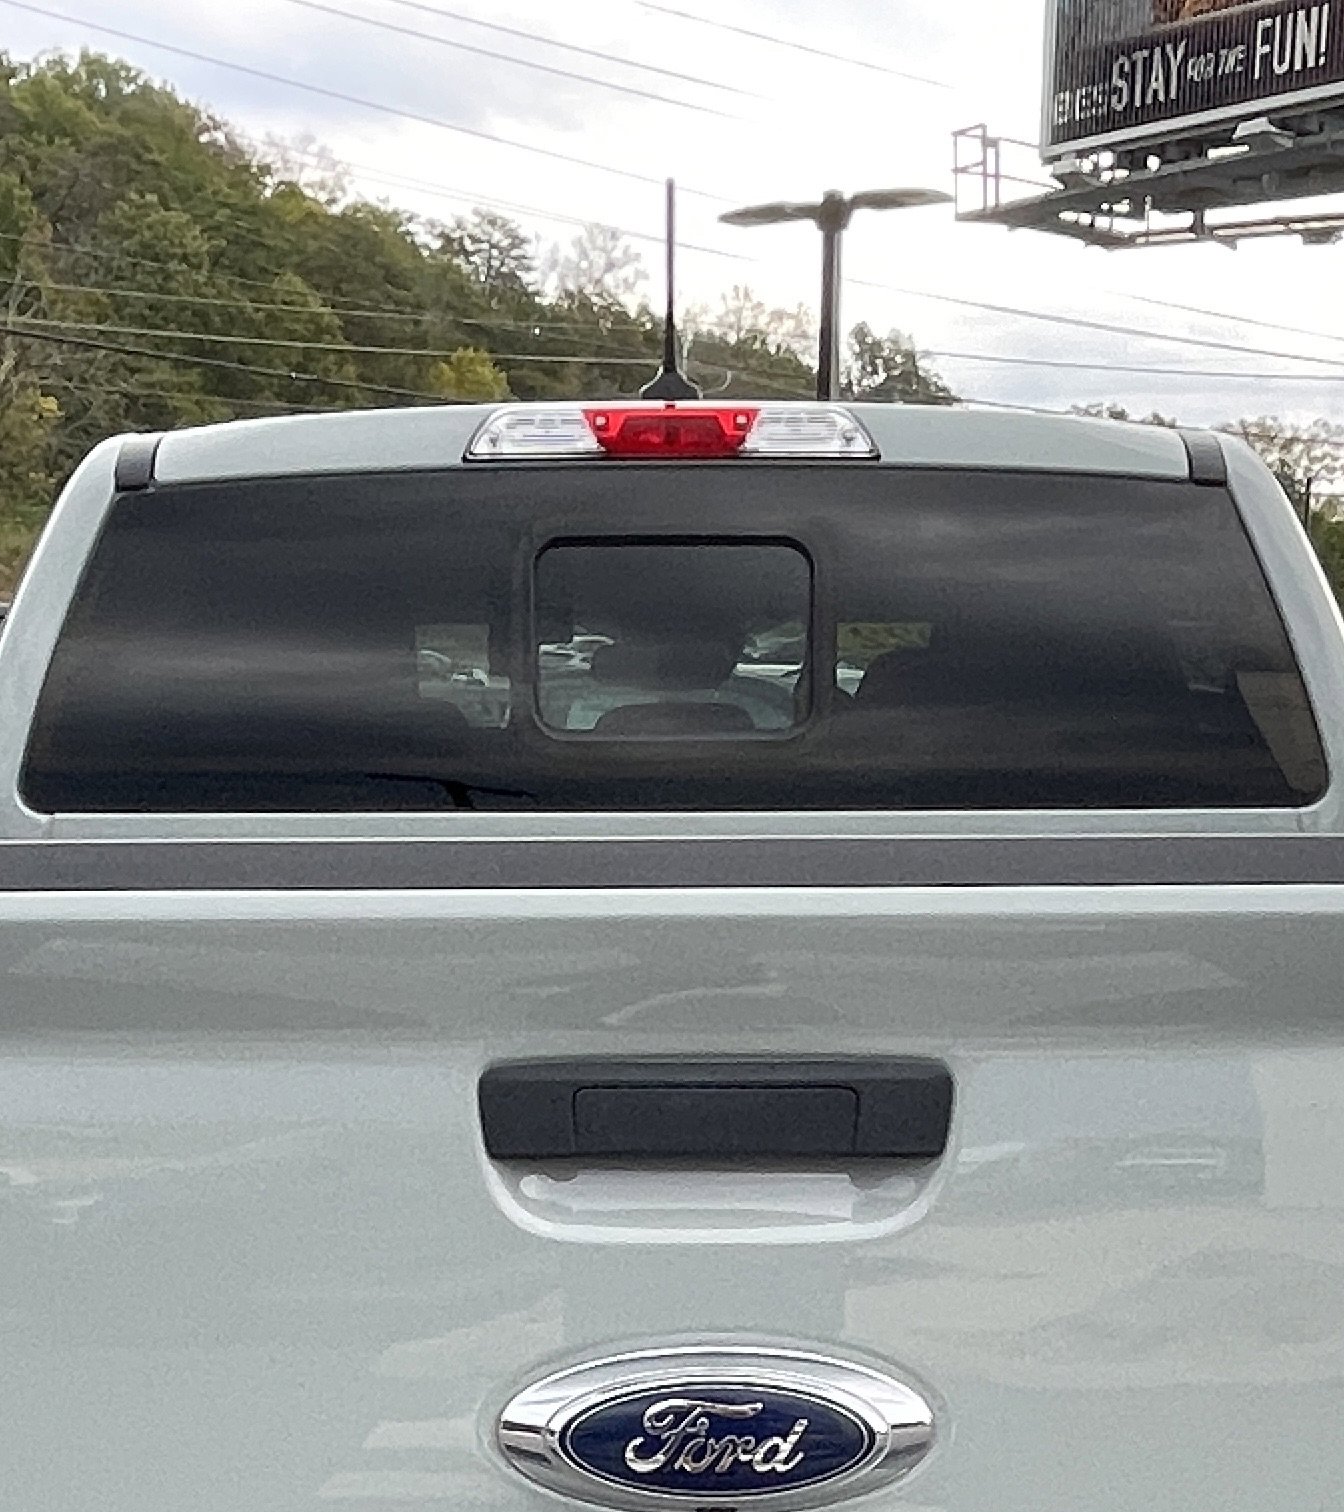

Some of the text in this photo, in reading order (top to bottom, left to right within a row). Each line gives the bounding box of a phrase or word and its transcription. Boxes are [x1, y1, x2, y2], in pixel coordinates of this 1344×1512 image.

[1110, 38, 1187, 112] STAY
[1254, 3, 1330, 80] FUN!
[624, 1397, 809, 1474] Ford
